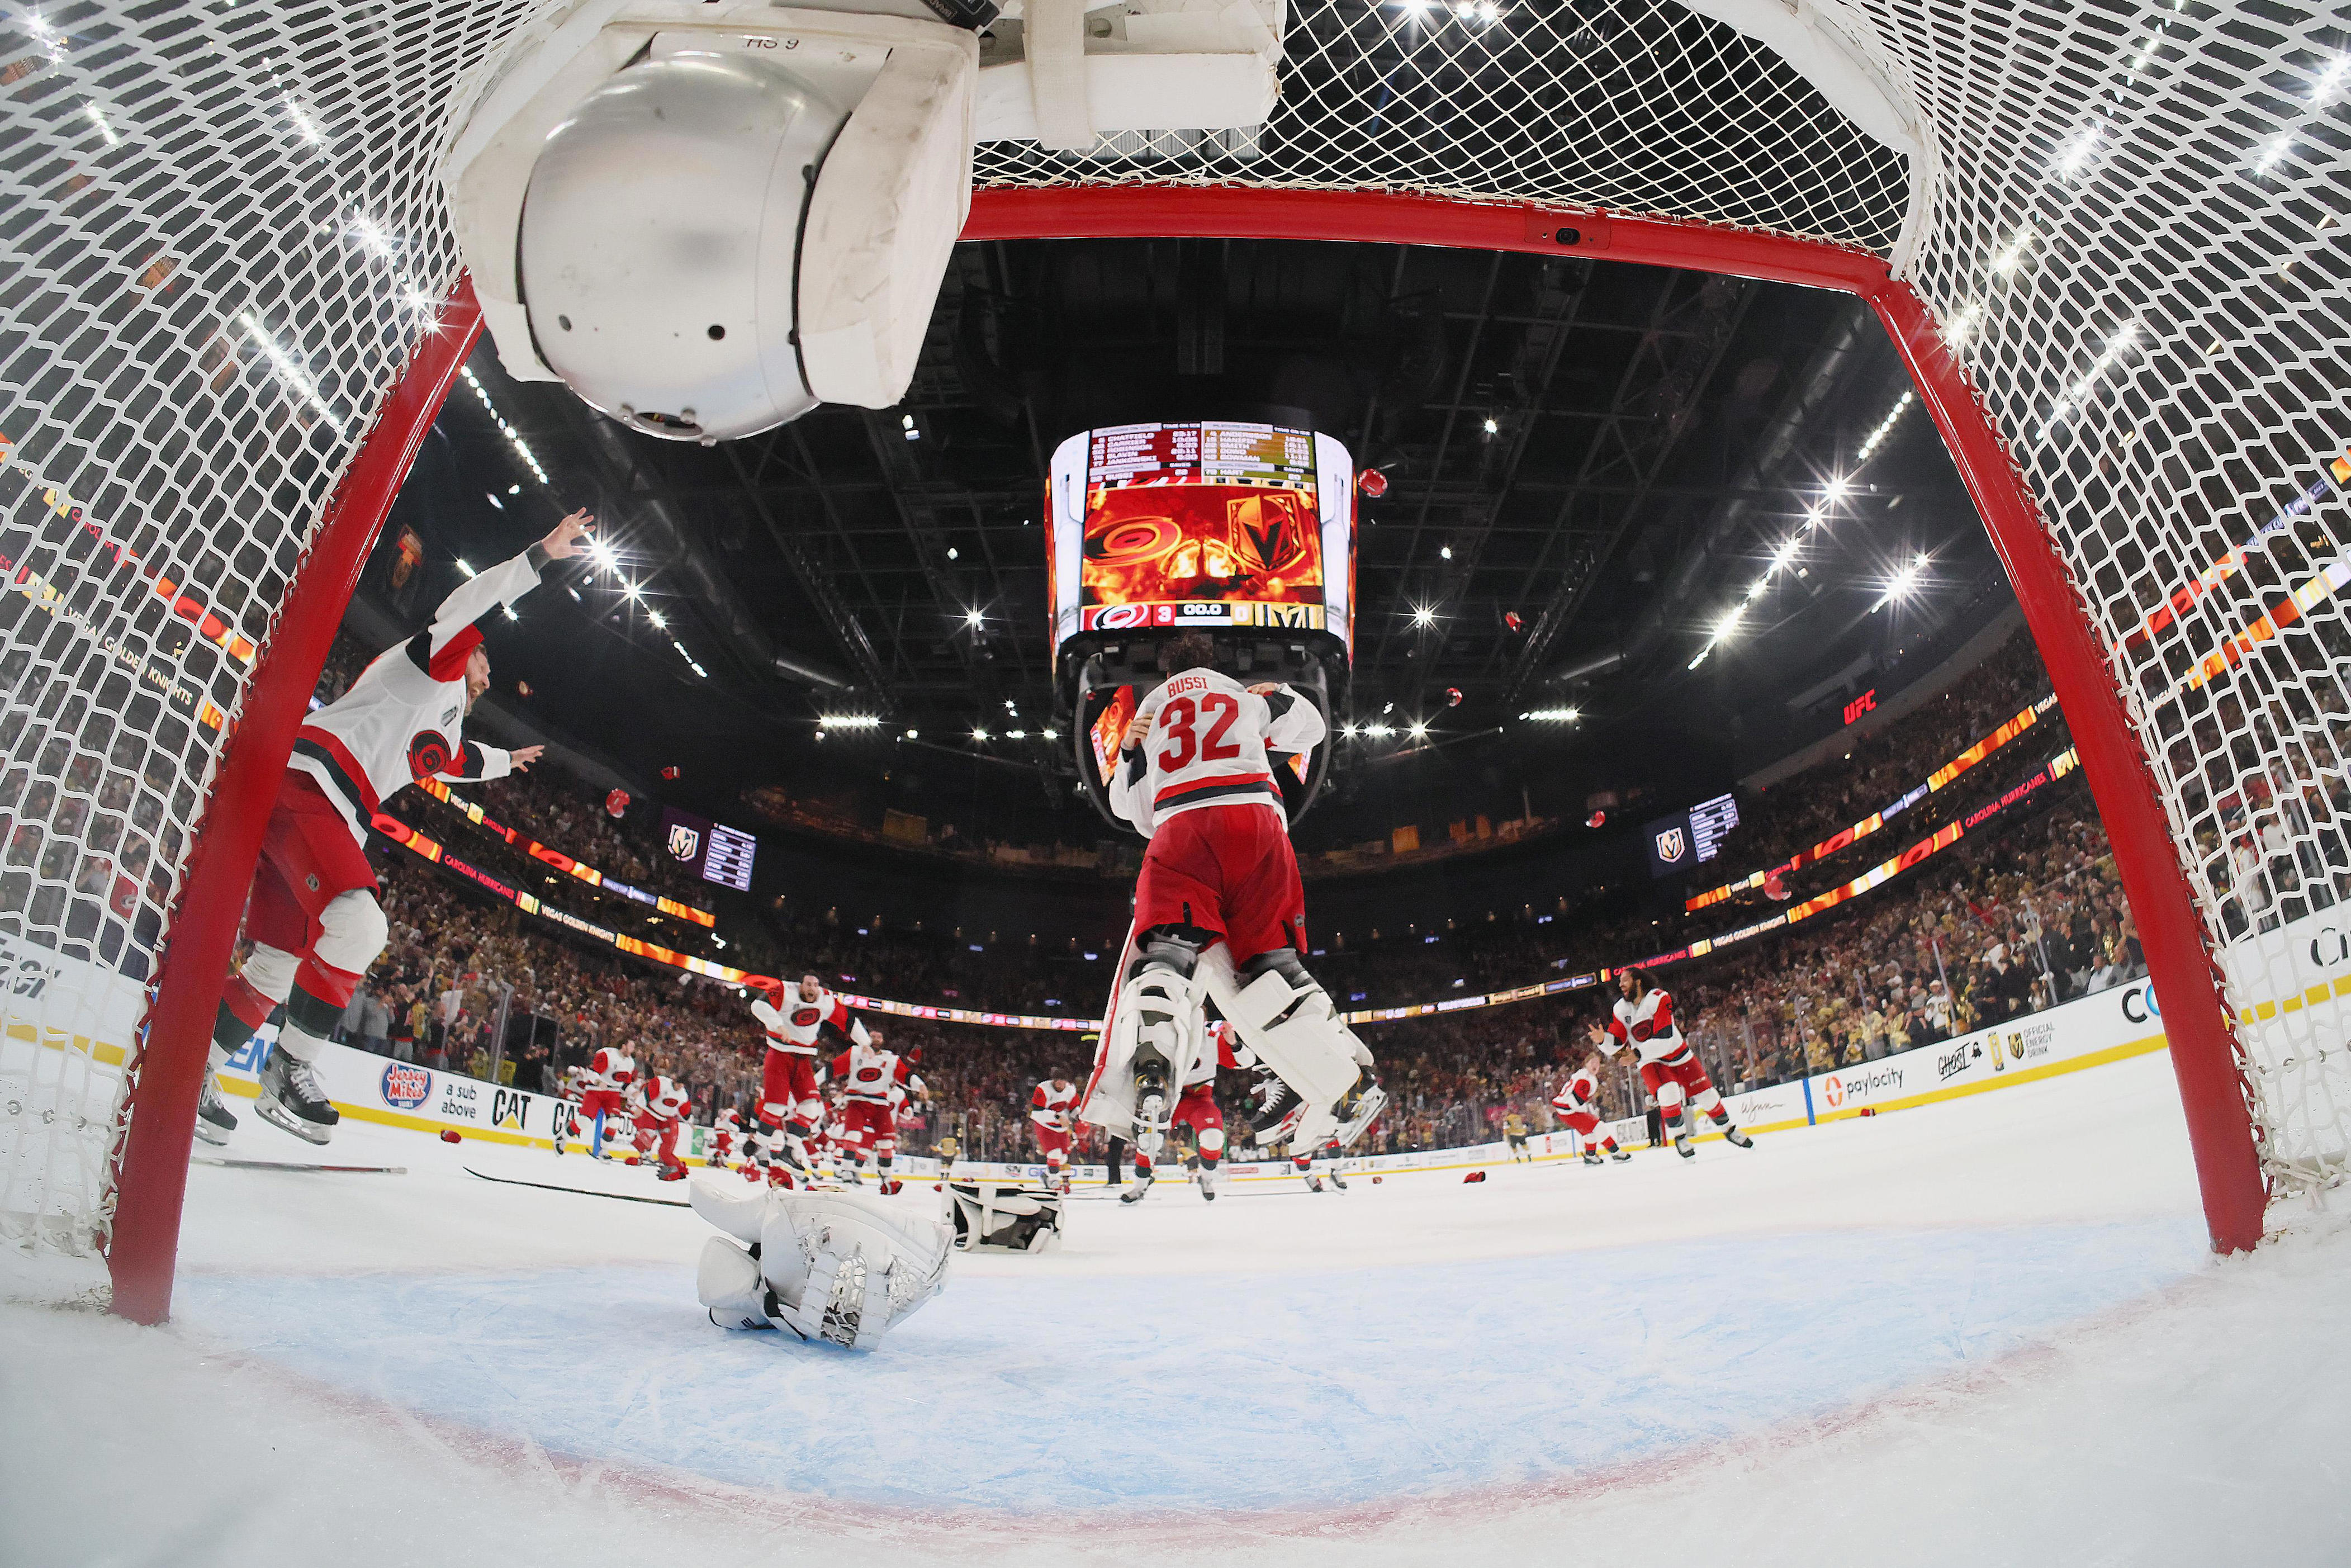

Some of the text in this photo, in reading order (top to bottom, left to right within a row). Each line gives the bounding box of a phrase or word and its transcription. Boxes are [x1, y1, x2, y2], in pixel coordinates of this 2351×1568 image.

[1158, 605, 1172, 622] 3
[1183, 604, 1222, 615] 00.0
[1238, 607, 1249, 623] 0
[1167, 676, 1208, 698] BUSSI
[1843, 688, 1877, 725] UFC
[1159, 692, 1240, 774] 32
[1965, 800, 2001, 828] CAROLINA
[2000, 772, 2046, 807] HURRICANES
[2023, 1021, 2055, 1037] OFFICIAL
[2026, 1034, 2052, 1048] ENERGY
[1938, 1041, 1971, 1078] GHOST
[388, 1064, 428, 1086] Jersey
[1847, 1067, 1903, 1100] paylocity
[446, 1083, 477, 1100] a sub
[442, 1099, 476, 1119] above
[492, 1089, 531, 1130] CAT
[553, 1102, 580, 1135] CA
